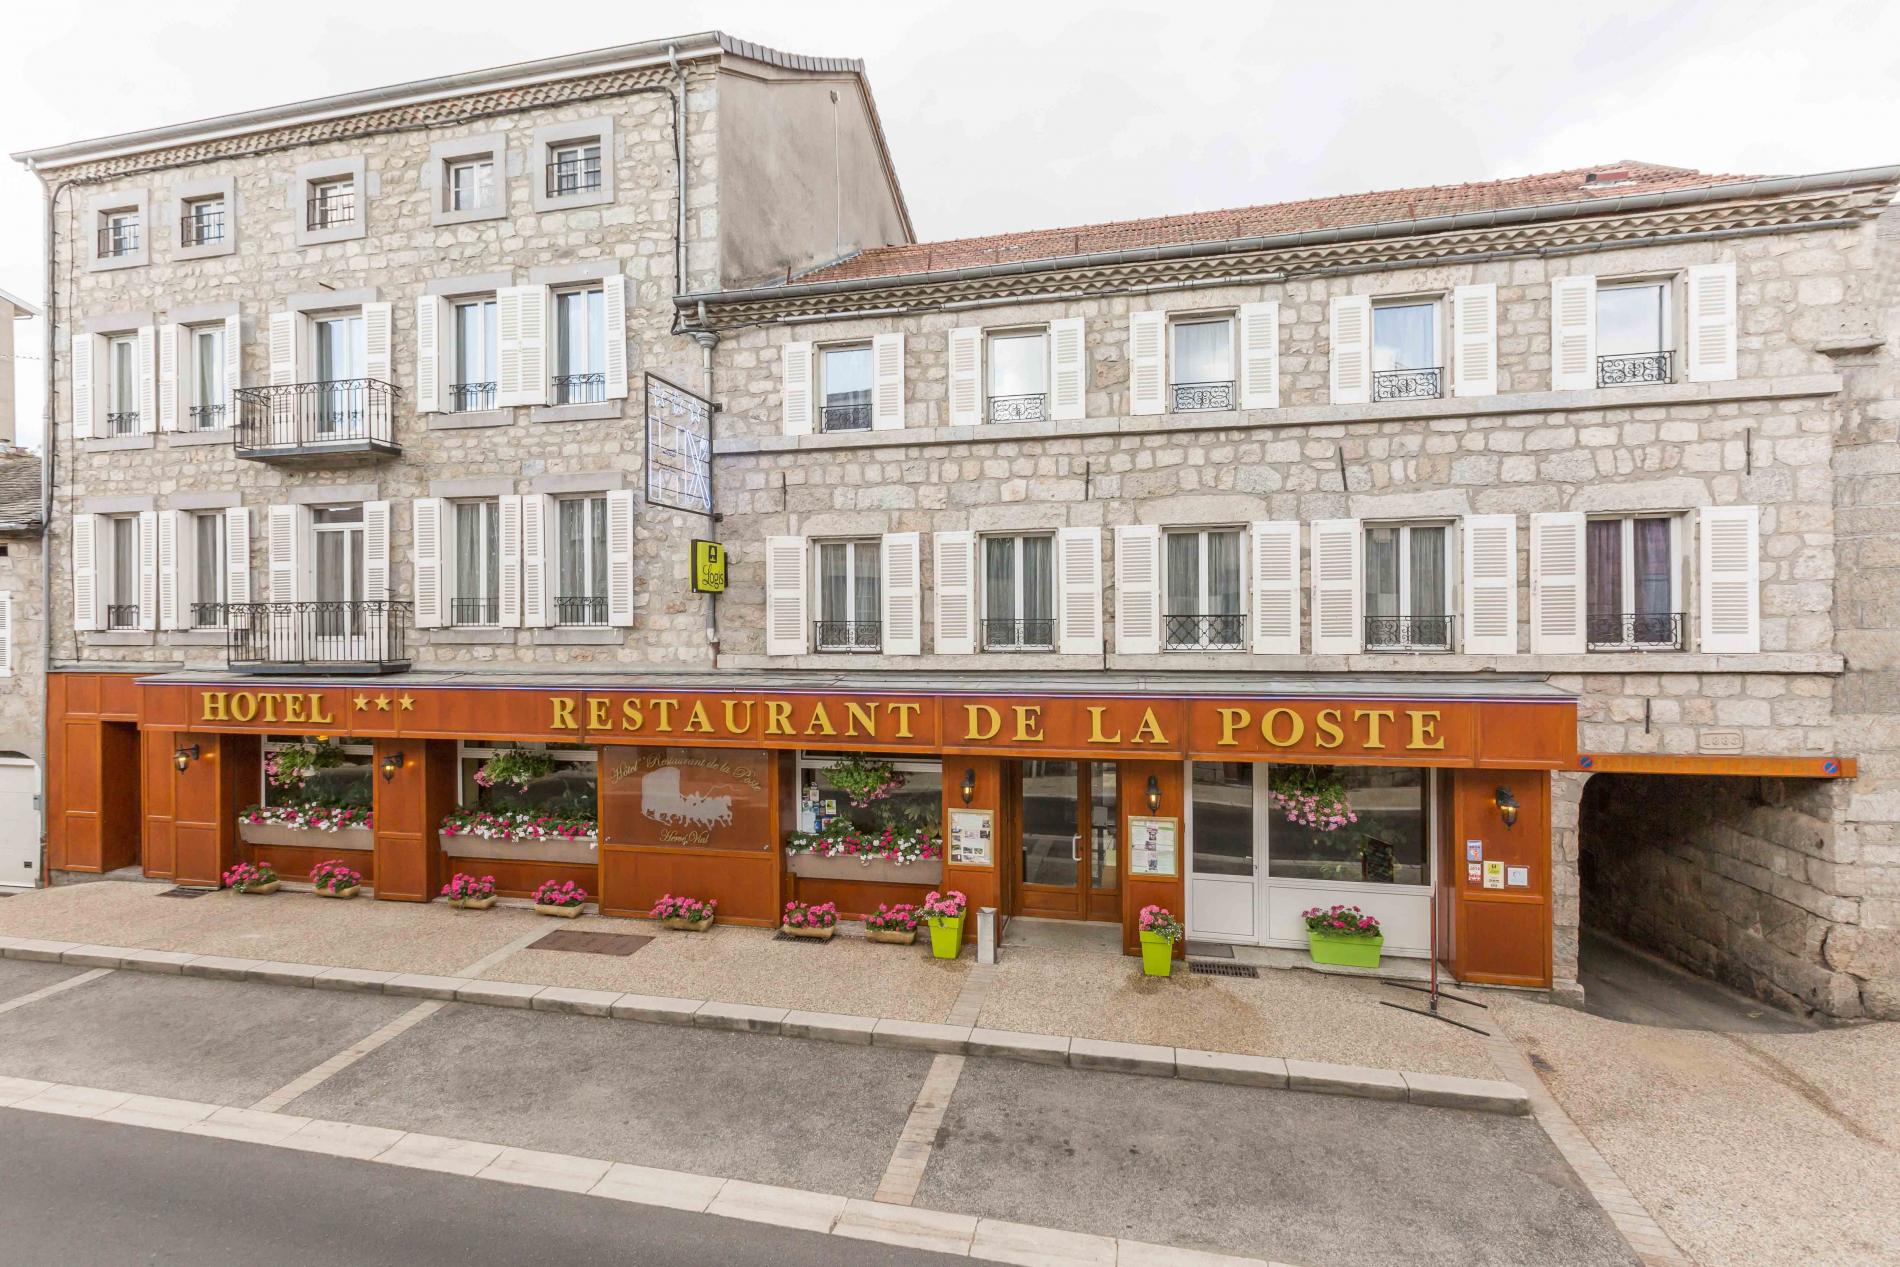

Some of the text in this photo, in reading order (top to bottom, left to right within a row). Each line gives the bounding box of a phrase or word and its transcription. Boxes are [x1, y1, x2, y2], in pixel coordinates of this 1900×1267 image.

[702, 563, 724, 590] Logis
[202, 691, 1446, 749] HOTEL RESTAURANT DE LA POSTE
[646, 752, 706, 768] Restaurant
[706, 758, 720, 769] de
[719, 762, 731, 774] la
[732, 766, 762, 791] Poste
